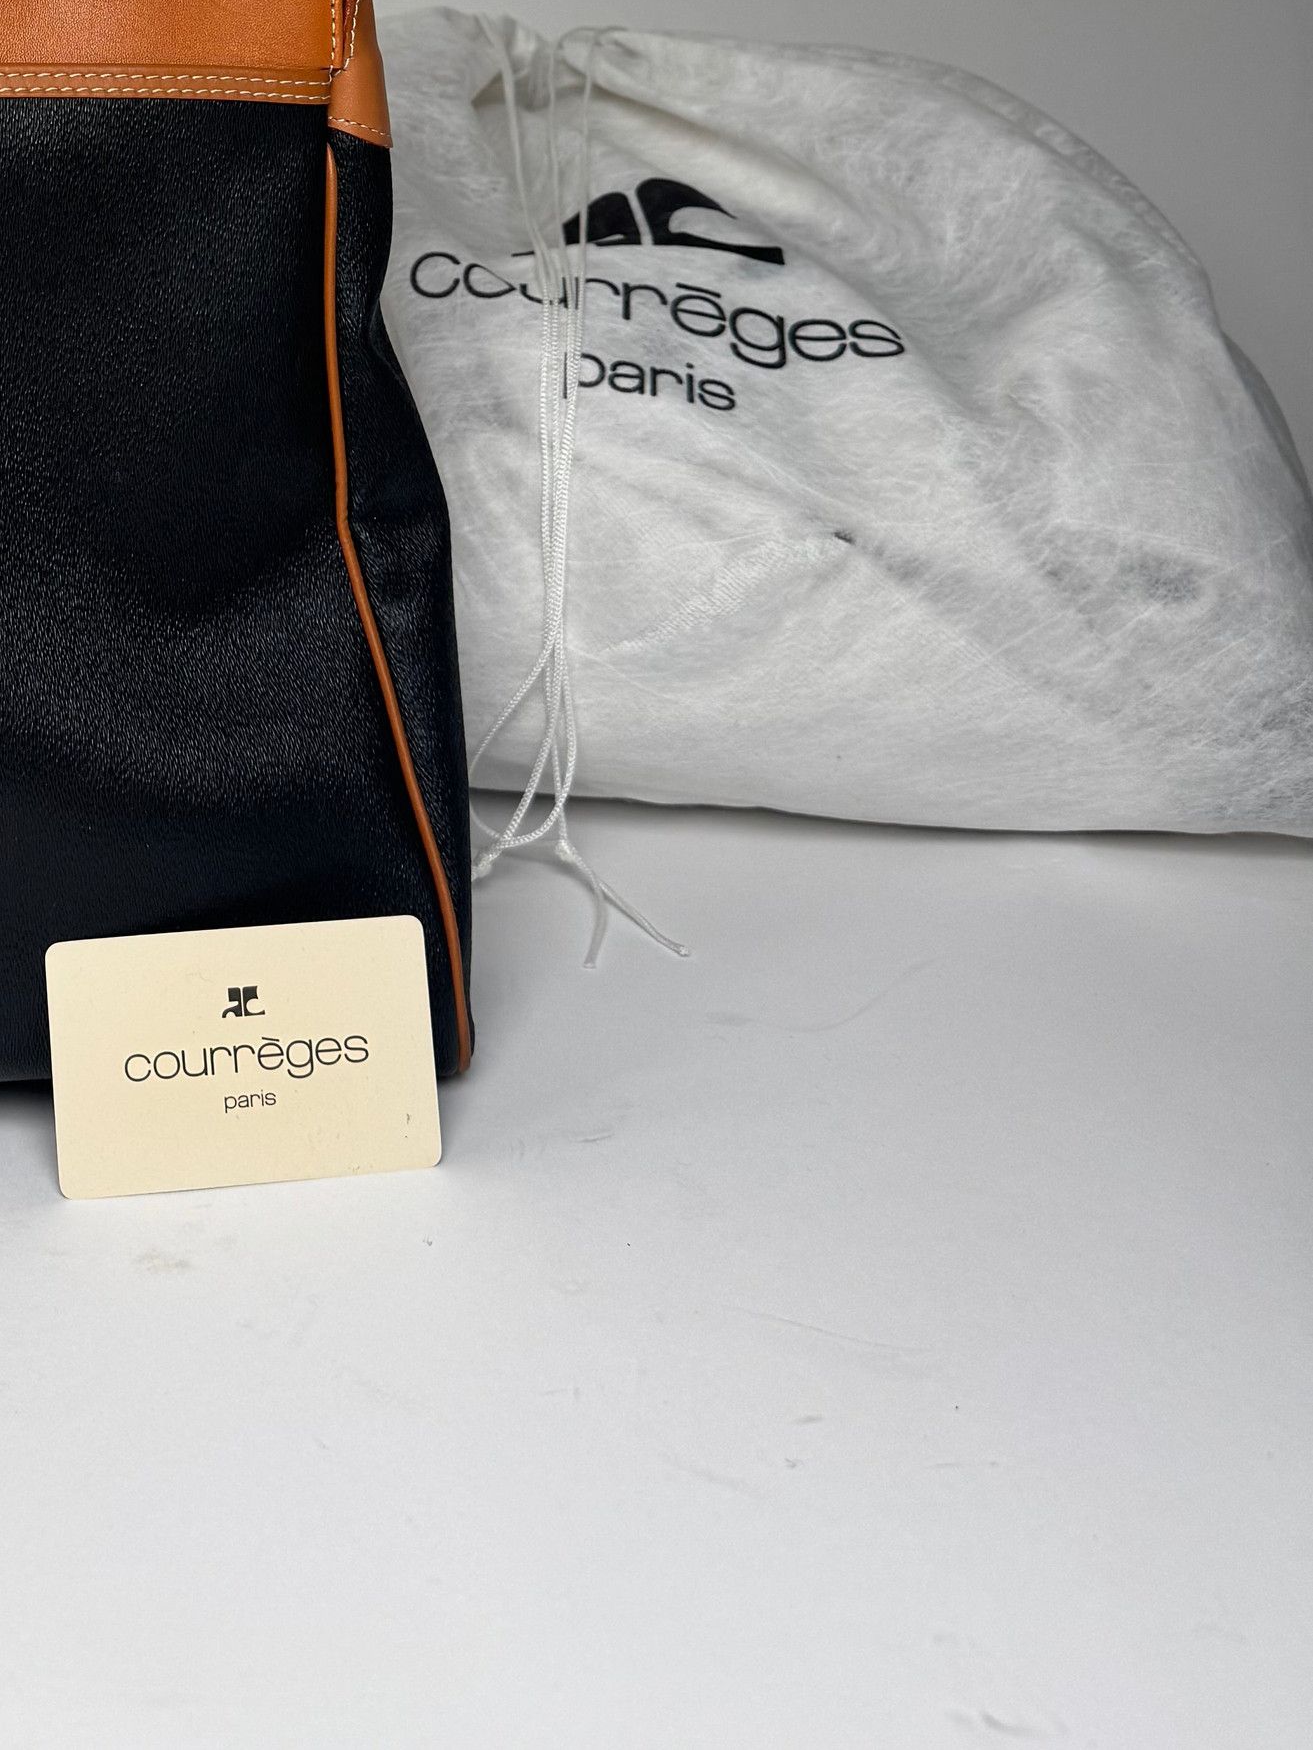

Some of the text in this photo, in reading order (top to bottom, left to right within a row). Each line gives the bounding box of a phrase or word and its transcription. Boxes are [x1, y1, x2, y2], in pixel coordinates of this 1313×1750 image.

[562, 350, 736, 411] paris
[124, 1034, 370, 1082] courrèges
[223, 1089, 277, 1114] paris
